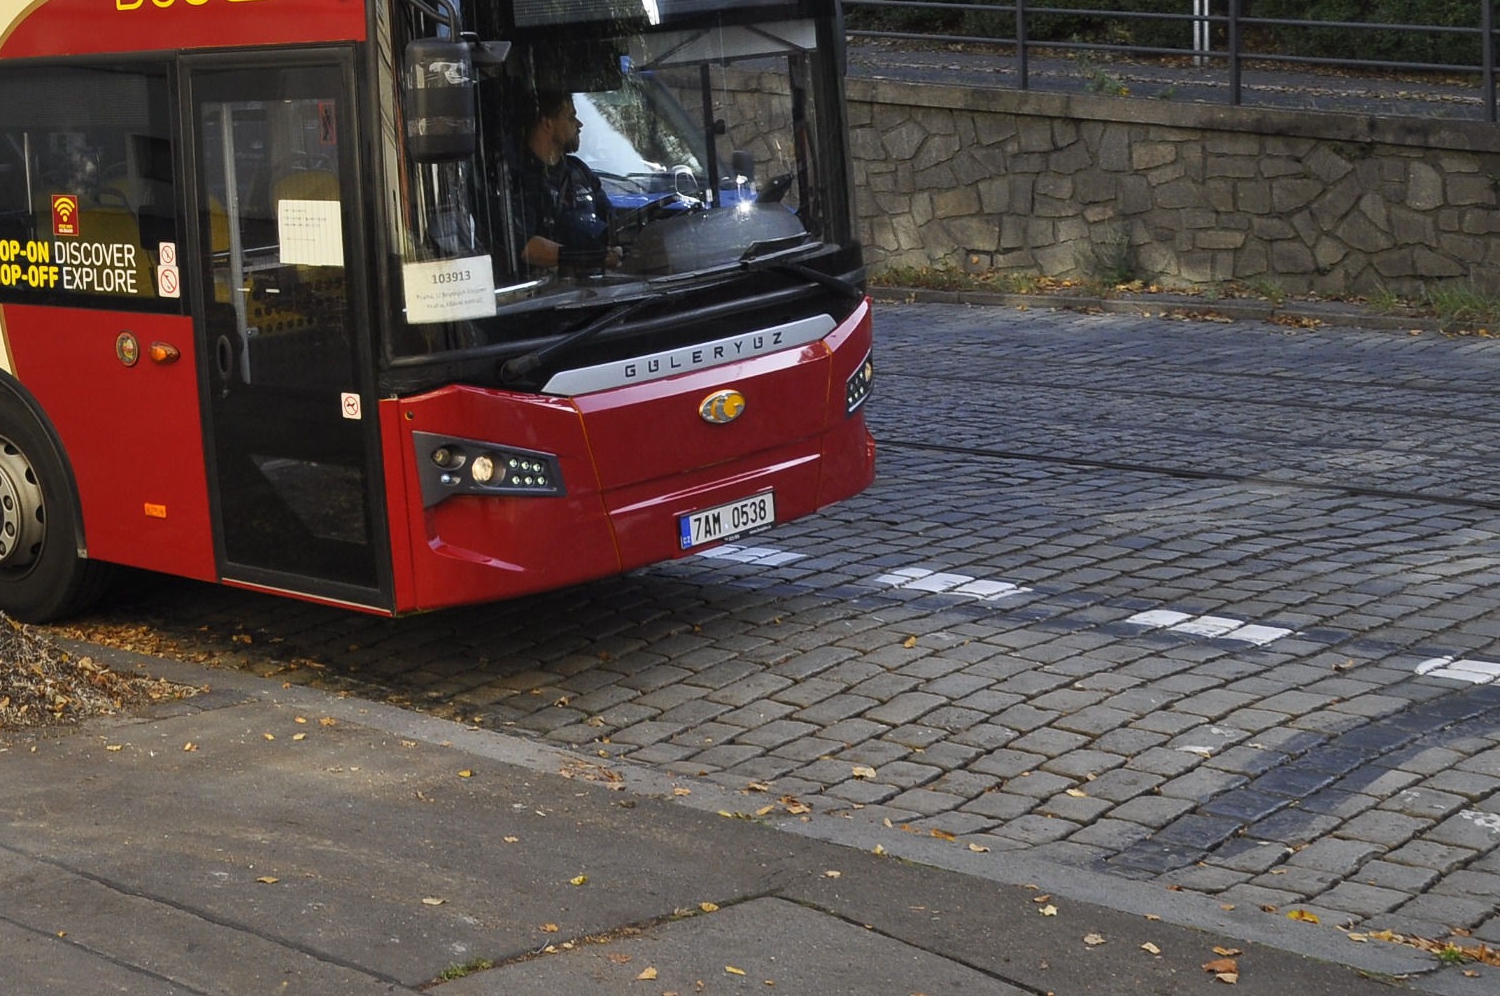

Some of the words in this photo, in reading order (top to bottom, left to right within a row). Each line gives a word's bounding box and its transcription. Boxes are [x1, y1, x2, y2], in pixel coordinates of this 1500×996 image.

[54, 241, 136, 267] DISCOVER
[62, 266, 138, 293] EXPLORE
[432, 270, 471, 284] 103913
[693, 511, 722, 541] 7AM
[731, 498, 767, 529] 0538
